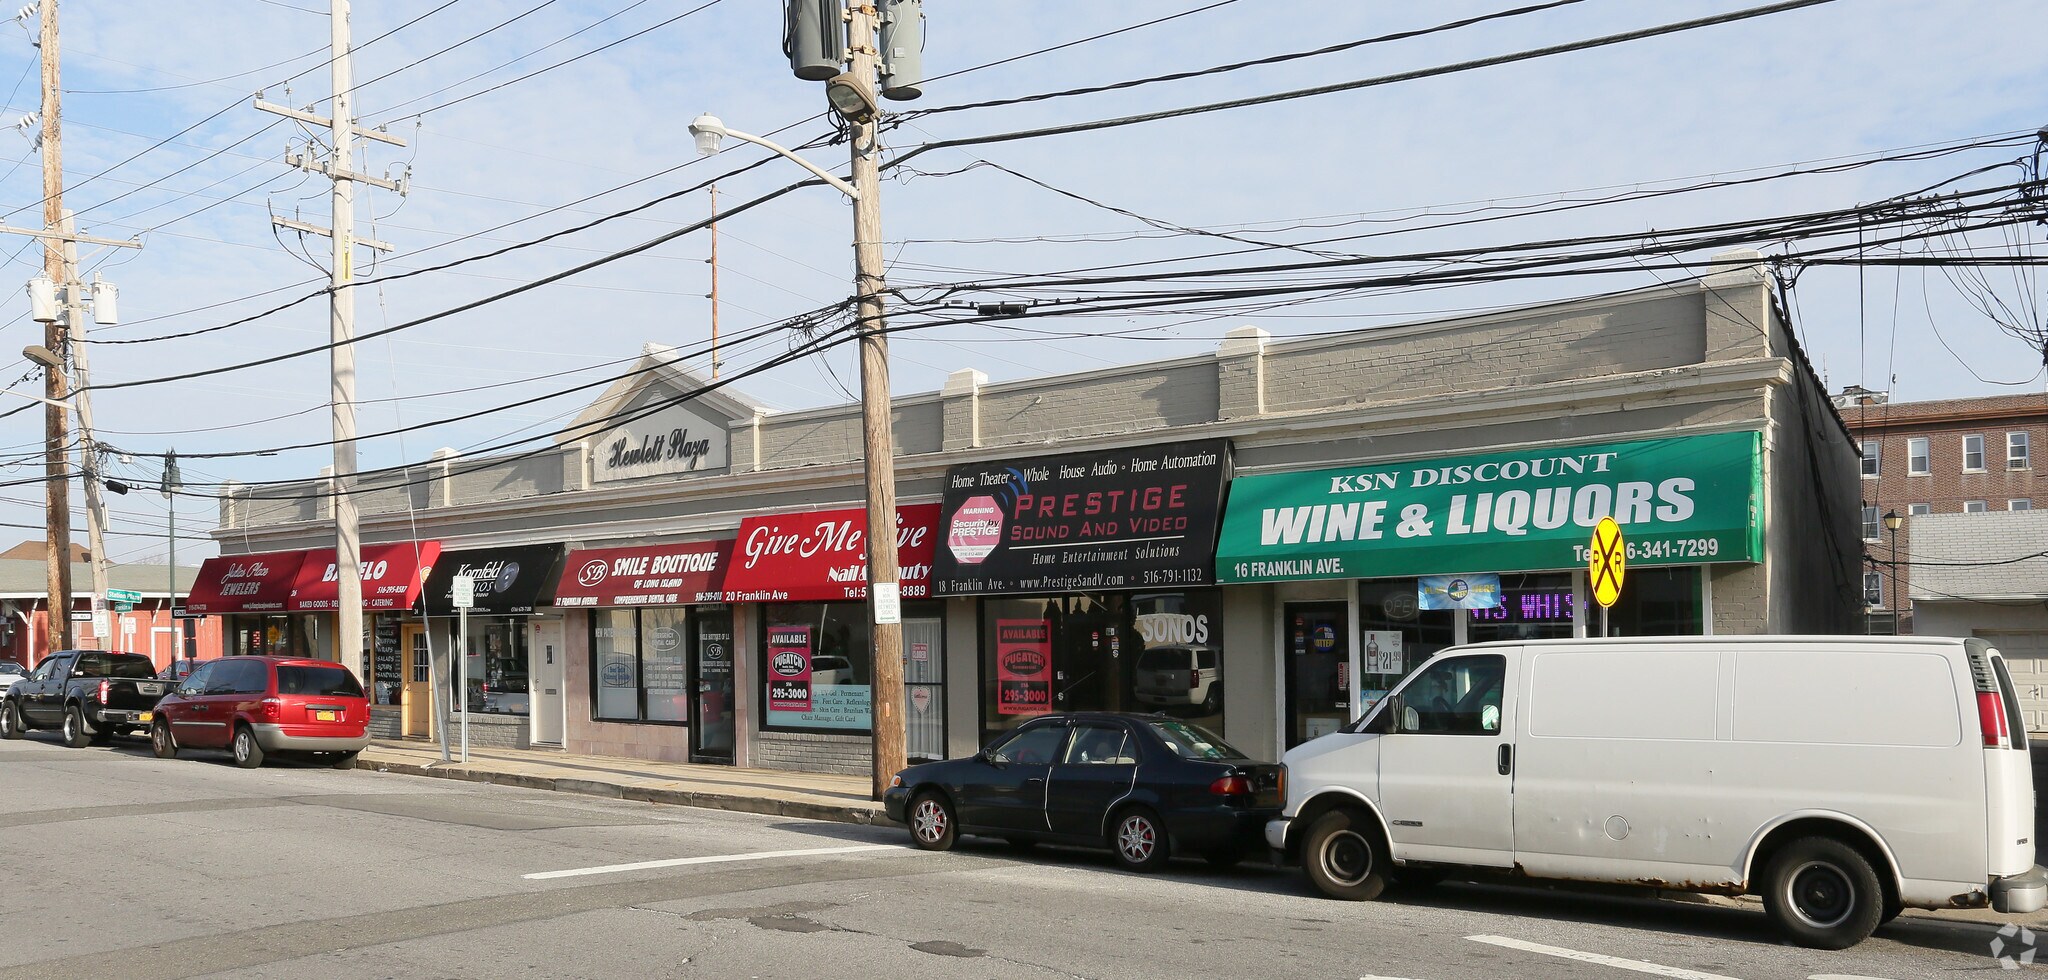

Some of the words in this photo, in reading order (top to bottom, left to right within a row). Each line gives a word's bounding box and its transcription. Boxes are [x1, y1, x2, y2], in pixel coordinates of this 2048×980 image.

[609, 434, 665, 468] Hewlett
[667, 428, 710, 470] Plaza
[952, 474, 975, 488] Home
[980, 471, 1010, 486] Theater
[1023, 466, 1050, 482] Whole
[1059, 465, 1086, 479] House
[1091, 460, 1118, 476] Audio
[1131, 458, 1157, 473] Home
[1161, 451, 1217, 470] Automation
[1328, 471, 1401, 494] KSN
[1410, 453, 1618, 488] DISCOUNT
[1014, 484, 1188, 519] PRESTIGE
[963, 507, 994, 515] WARNING
[1260, 501, 1388, 546] WINE
[1395, 503, 1434, 538] &
[1446, 477, 1696, 536] LIQUORS
[952, 527, 999, 537] PRESTIGE
[1011, 525, 1069, 541] SOUND
[1080, 521, 1118, 537] AND
[1129, 517, 1188, 533] VIDEO
[745, 526, 799, 569] Give
[799, 520, 862, 558] Me
[1032, 553, 1056, 565] Home
[1062, 548, 1129, 563] Entertainment
[1135, 541, 1180, 560] Solutions
[611, 556, 650, 577] SMILE
[651, 552, 719, 575] BOUTIQUE
[1234, 563, 1248, 578] 16
[1251, 559, 1313, 577] FRANKLIN
[1316, 558, 1345, 574] AVE.
[1573, 545, 1590, 562] Te
[1592, 551, 1600, 572] R
[1614, 551, 1622, 573] R
[322, 560, 388, 582] BAELO
[633, 579, 642, 589] OF
[643, 579, 660, 589] LONG
[660, 578, 683, 589] ISLAND
[938, 581, 947, 593] 18
[951, 578, 983, 592] Franklin
[988, 578, 1005, 590] Ave.
[1020, 573, 1124, 590] www.PrestigeSandV.com
[1143, 567, 1202, 584] 516-791-1132
[220, 581, 261, 596] JEWELERS
[726, 592, 735, 602] 20
[737, 589, 771, 601] Franklin
[772, 589, 789, 601] Ave
[313, 600, 328, 608] GOODS
[372, 598, 393, 606] CATERING
[581, 597, 598, 606] AVENUE
[648, 594, 665, 603] DENTAL
[666, 594, 678, 603] CARE
[1003, 629, 1046, 639] AVAILABLE
[1142, 614, 1208, 644] SONOS
[771, 634, 807, 644] AVAILABLE
[775, 653, 803, 669] PUGATCH
[1005, 652, 1044, 667] PUGATCH
[772, 688, 807, 699] 295-3000
[1004, 690, 1046, 702] 295-3000
